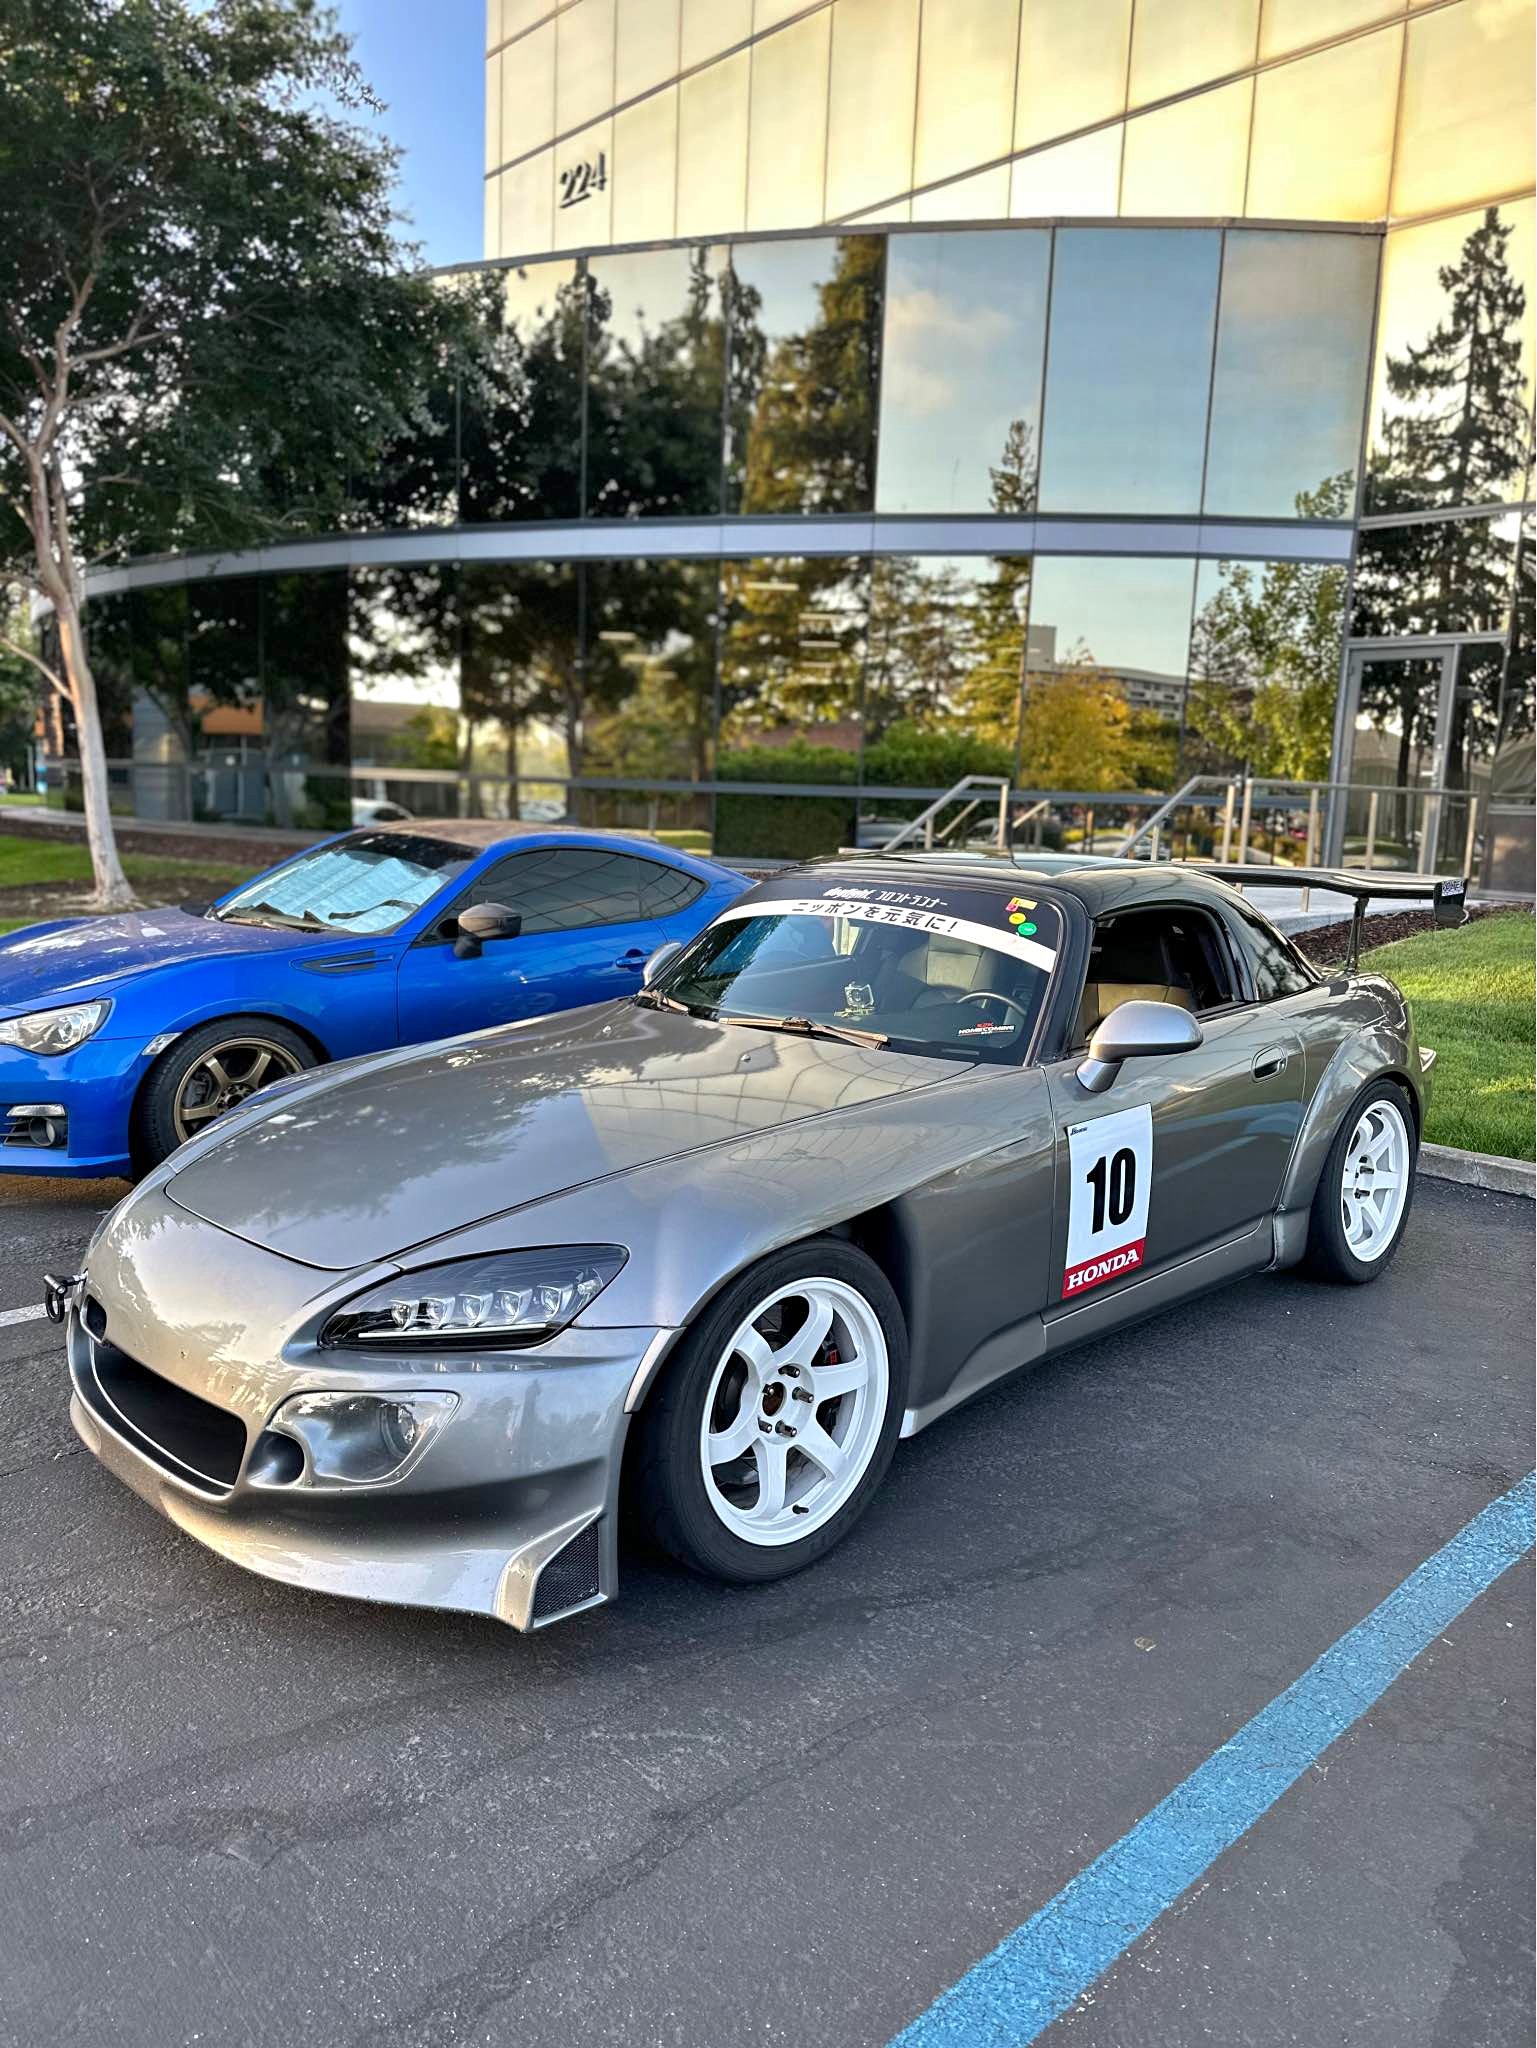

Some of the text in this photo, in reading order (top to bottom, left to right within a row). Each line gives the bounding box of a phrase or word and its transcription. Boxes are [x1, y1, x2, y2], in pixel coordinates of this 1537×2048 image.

[559, 151, 608, 209] 224
[1086, 1147, 1136, 1235] 10
[1066, 1248, 1140, 1291] HONDA
